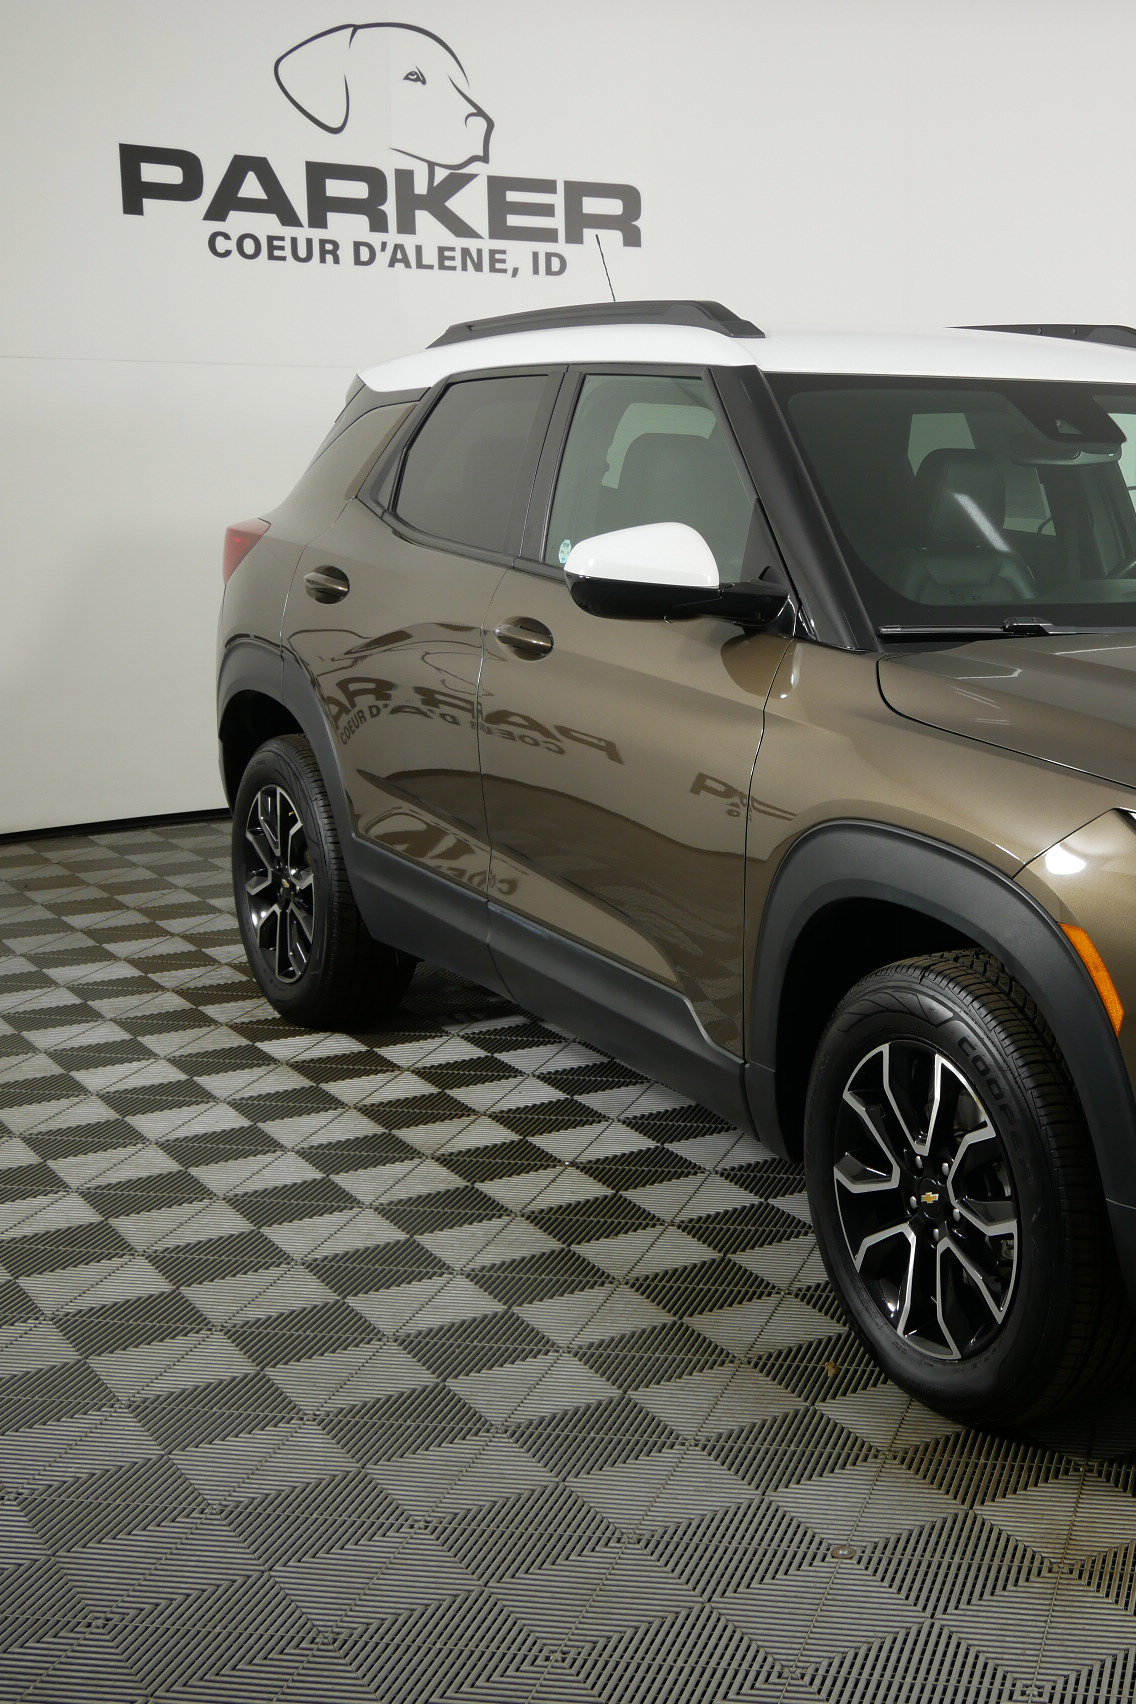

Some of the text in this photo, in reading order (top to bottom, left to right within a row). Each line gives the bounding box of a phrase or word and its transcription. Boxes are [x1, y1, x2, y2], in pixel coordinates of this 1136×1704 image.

[119, 143, 642, 248] PARKER
[208, 231, 568, 278] COEUR D'ALENE, ID
